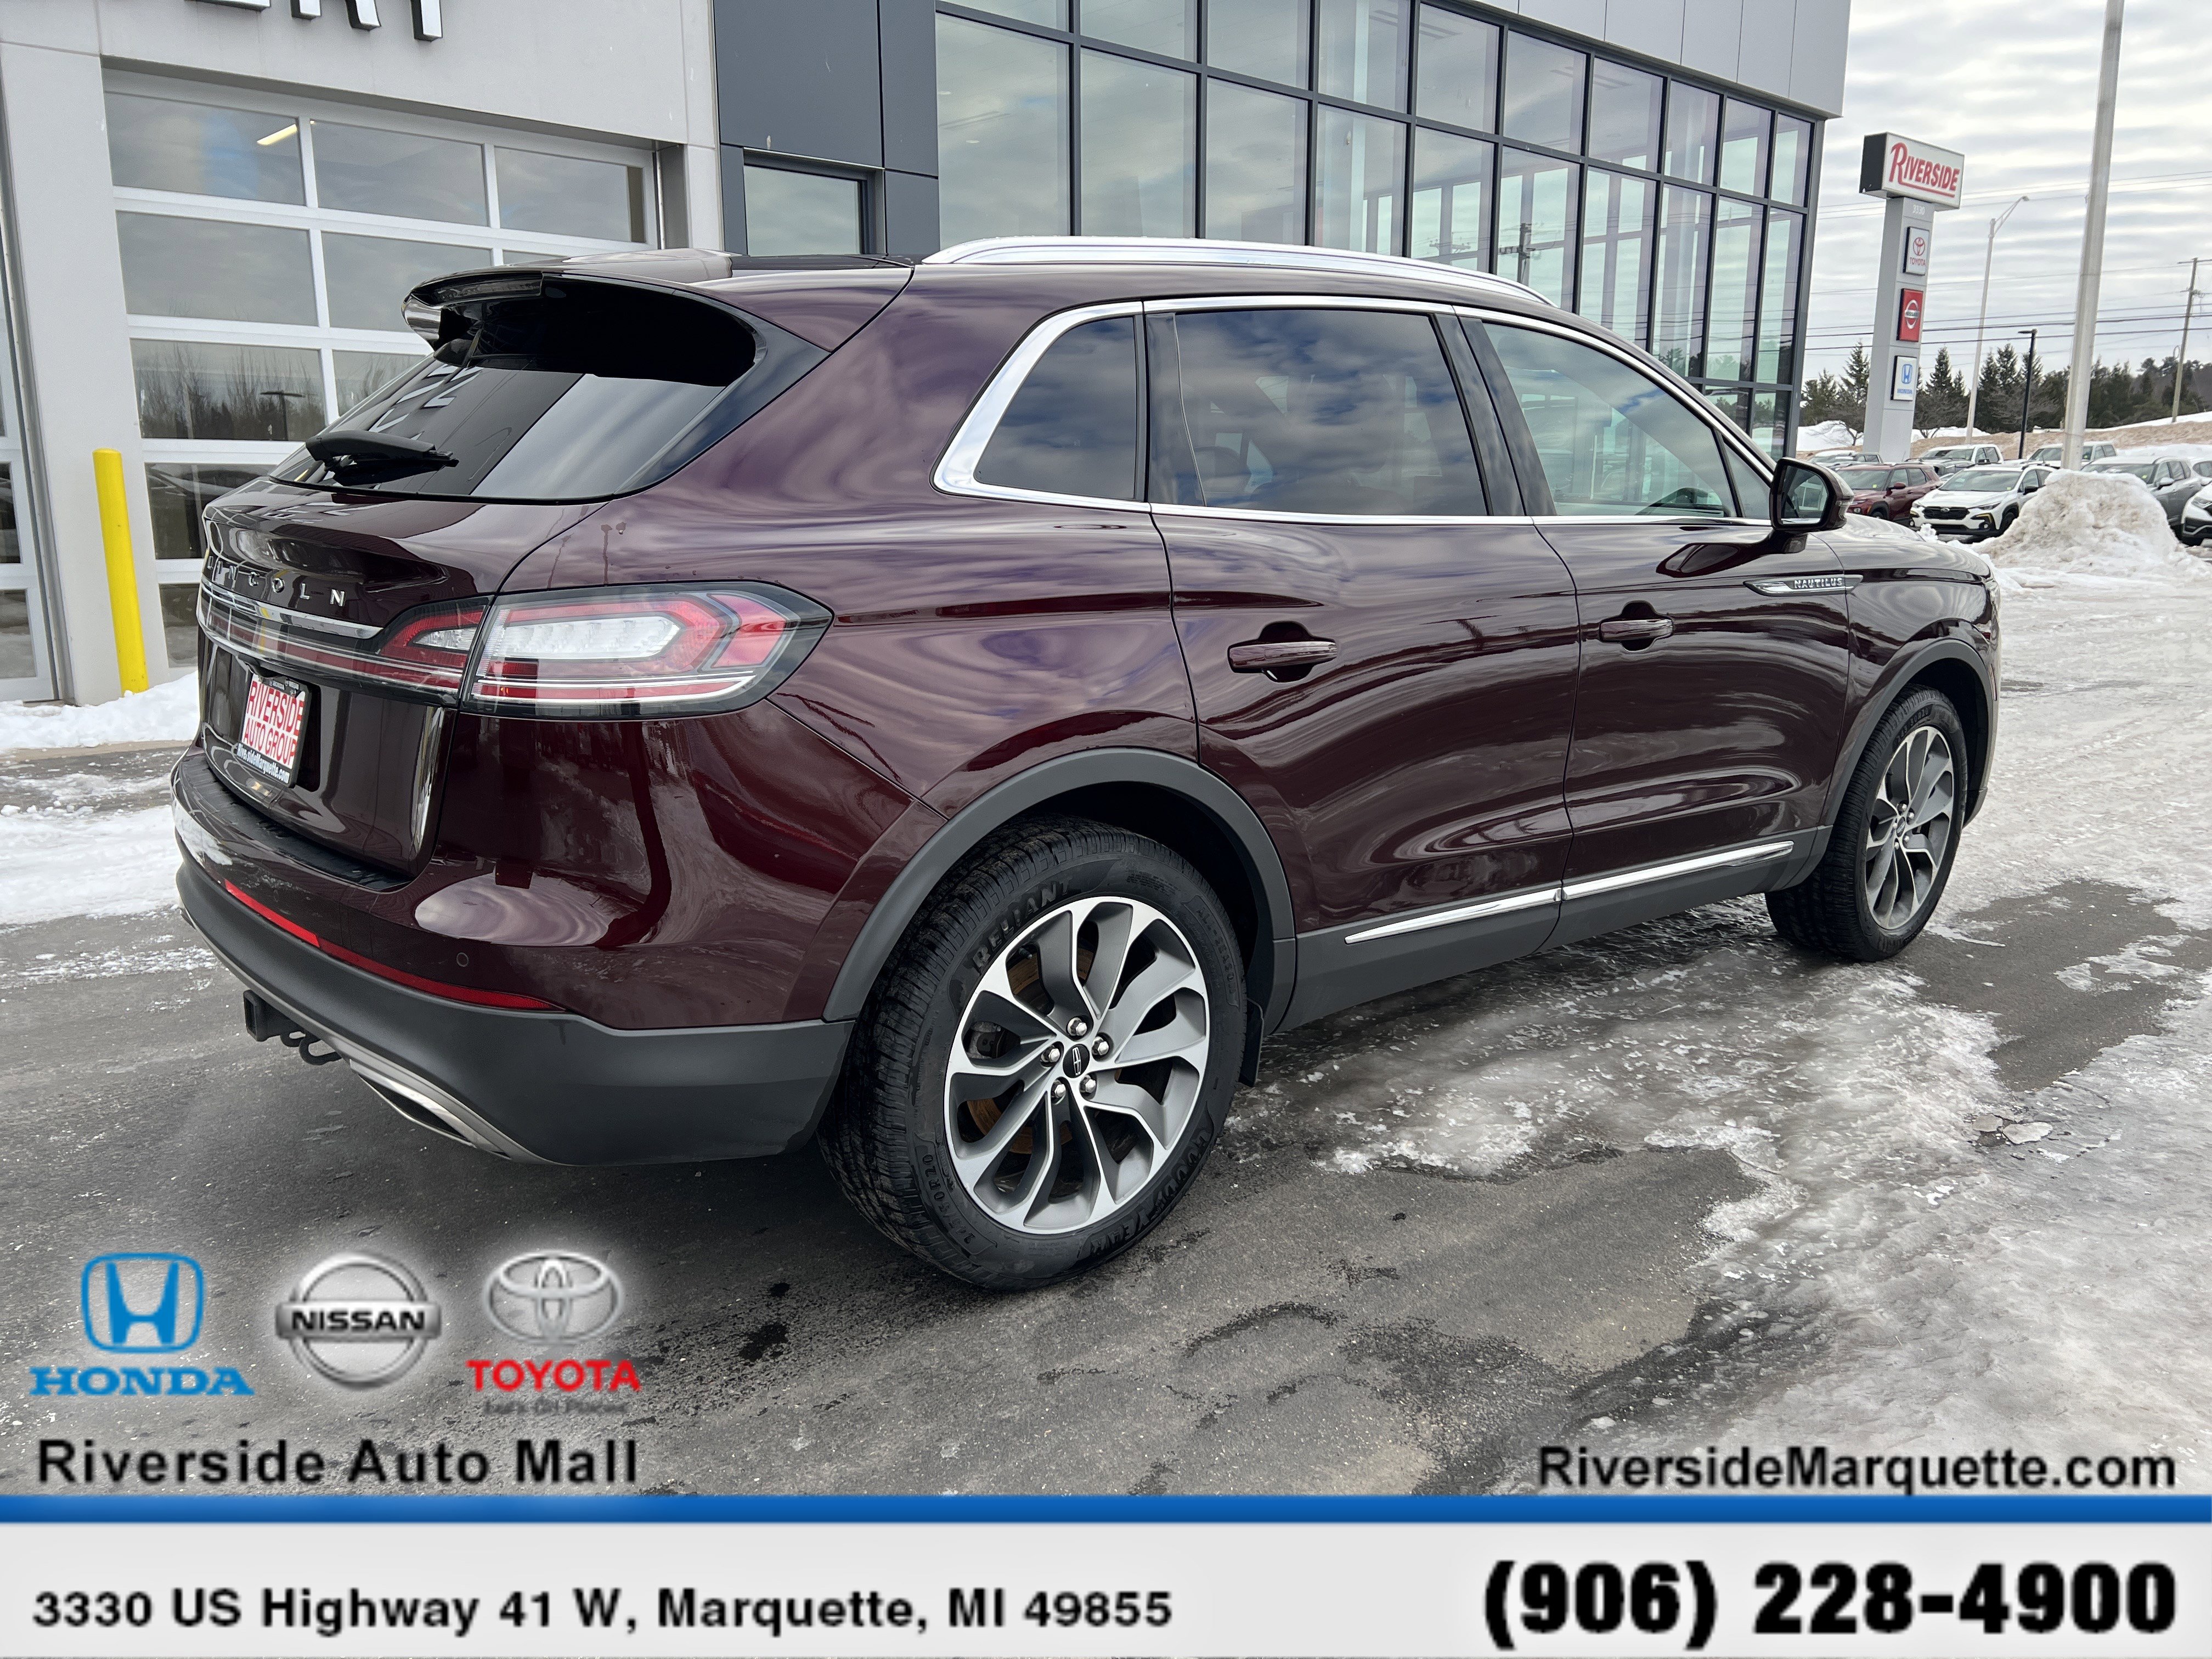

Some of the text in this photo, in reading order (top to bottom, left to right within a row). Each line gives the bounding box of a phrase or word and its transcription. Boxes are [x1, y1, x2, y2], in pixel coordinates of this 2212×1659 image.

[1888, 142, 1961, 192] RIVERSIDE
[1909, 256, 1926, 267] TOYOTA
[207, 555, 346, 607] LINCOLN
[1793, 577, 1843, 589] NAUTILUS
[247, 680, 306, 737] RIVERSIDE
[236, 742, 291, 784] RiversideMarquette.com
[243, 718, 298, 766] AUTO GROUP
